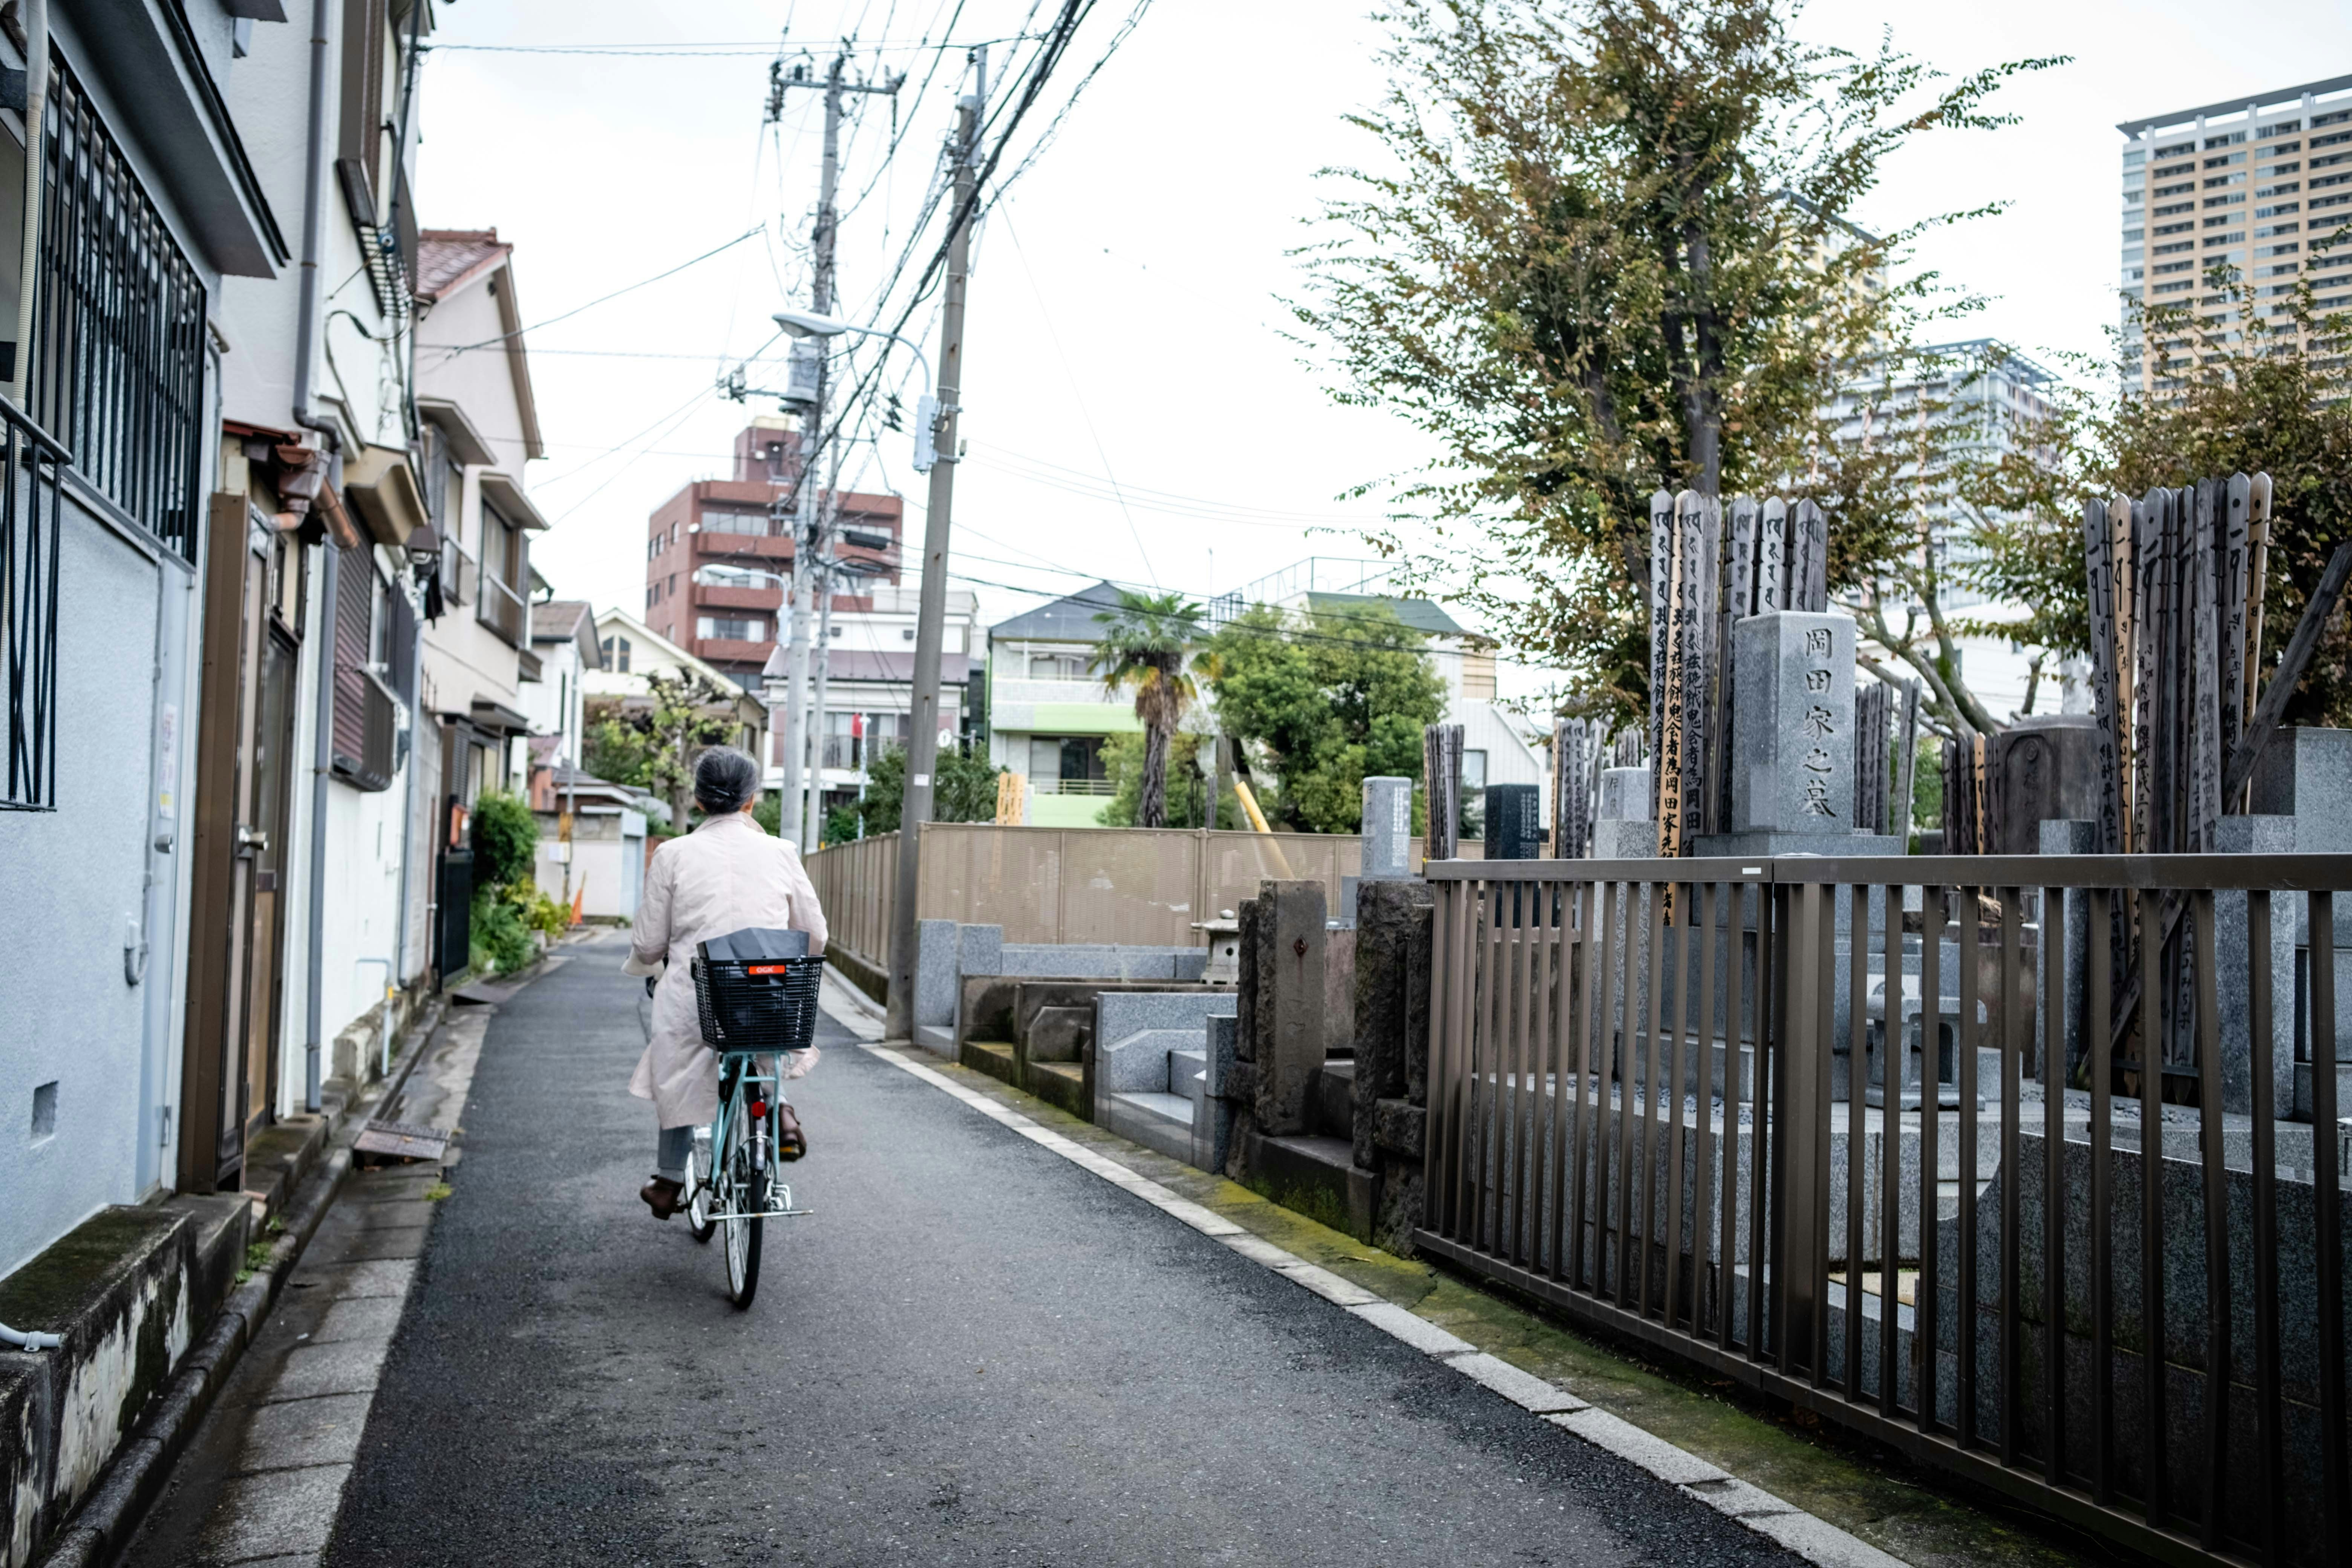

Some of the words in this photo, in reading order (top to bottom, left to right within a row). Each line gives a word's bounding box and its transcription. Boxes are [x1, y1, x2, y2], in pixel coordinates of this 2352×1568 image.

[1802, 628, 1837, 818] 岡田家之墓
